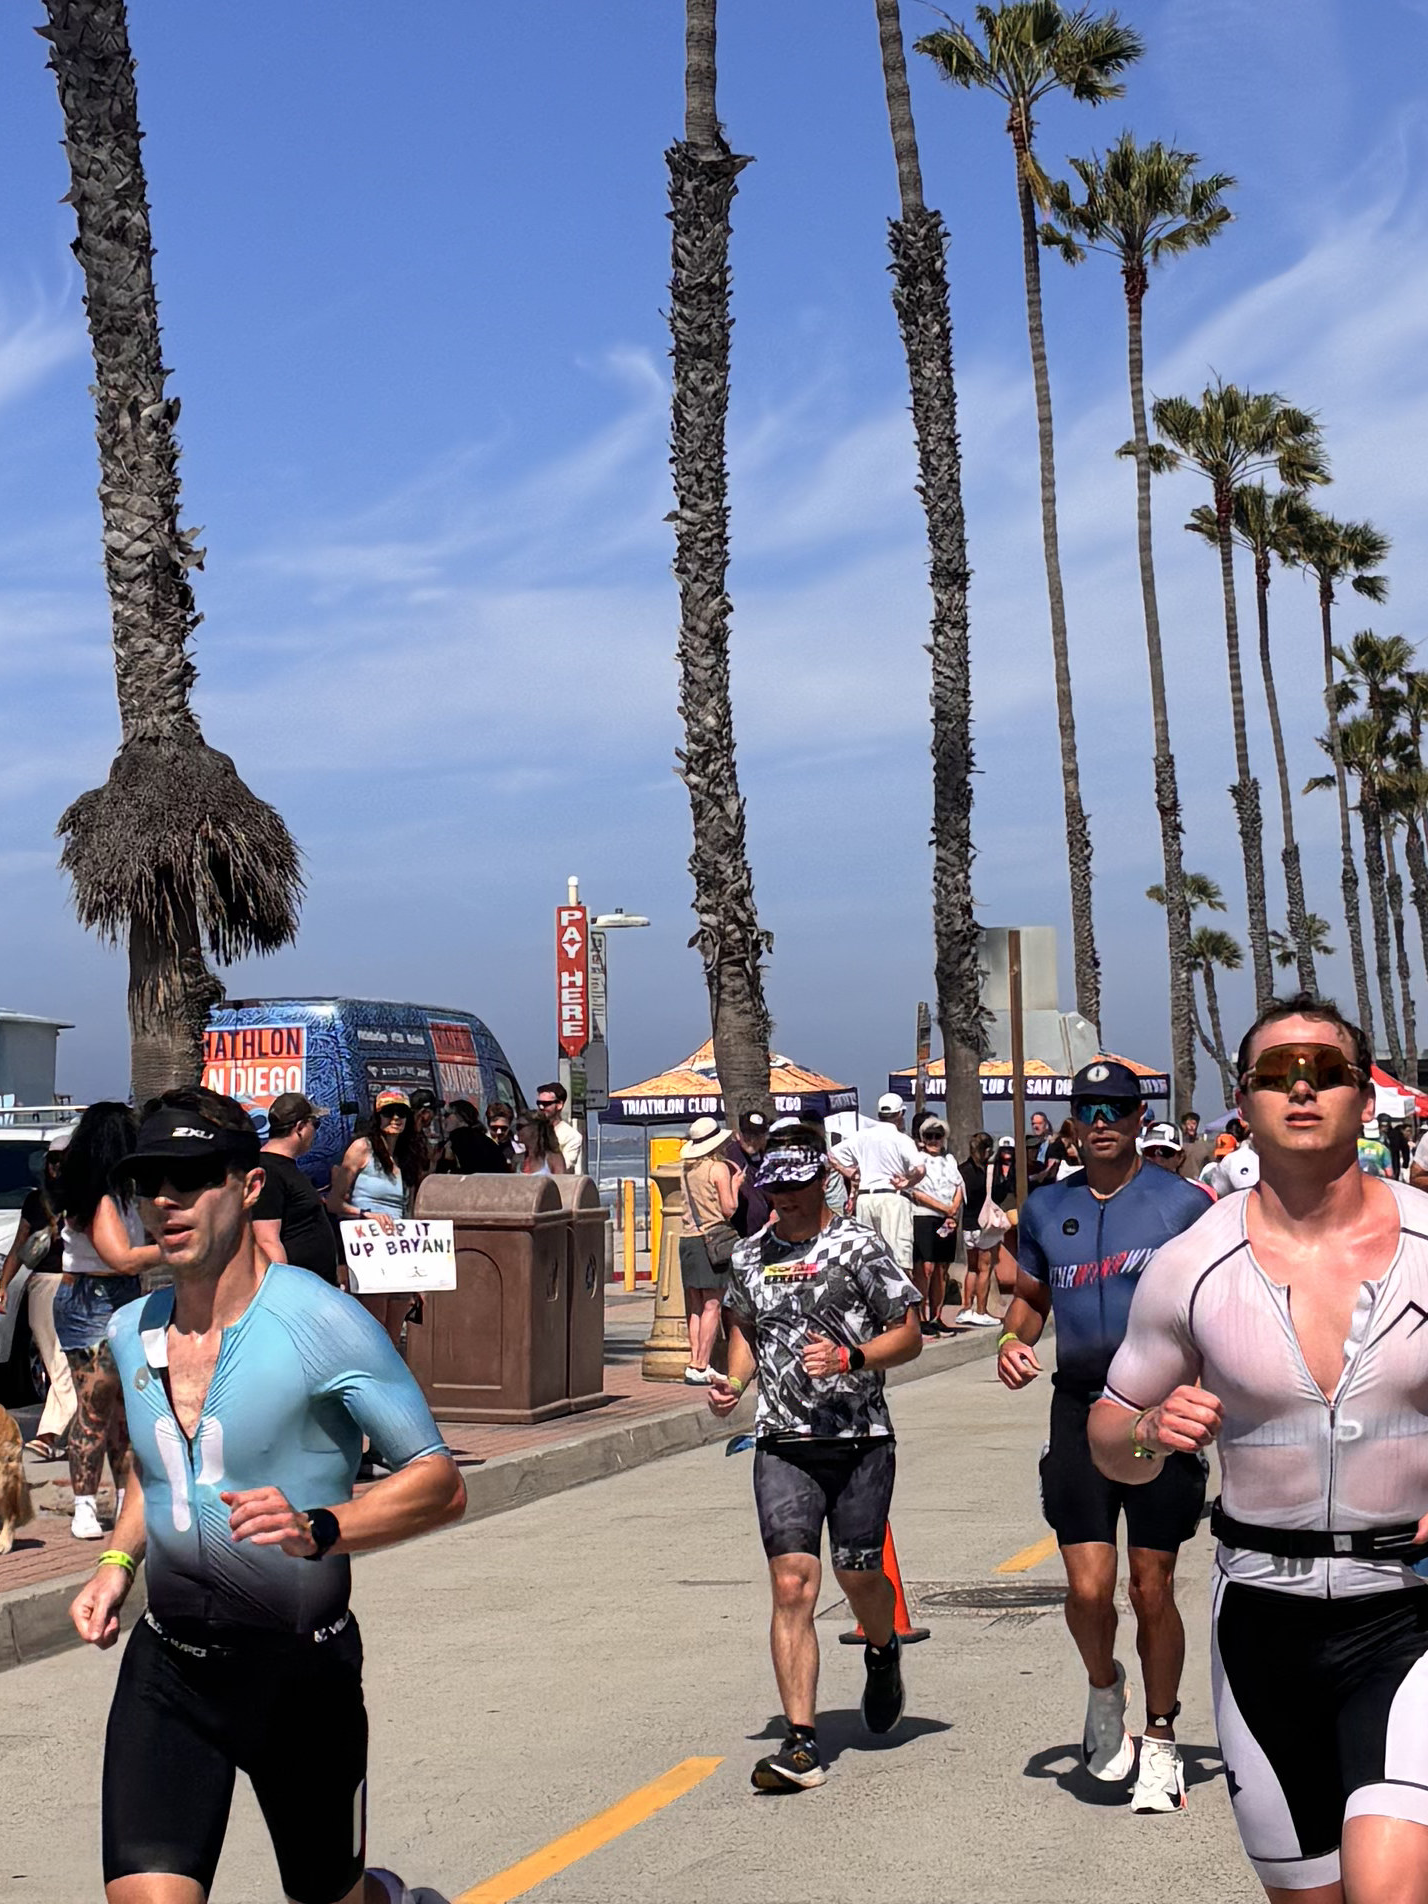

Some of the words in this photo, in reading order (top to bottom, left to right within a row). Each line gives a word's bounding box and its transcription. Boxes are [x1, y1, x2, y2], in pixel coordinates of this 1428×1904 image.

[560, 910, 584, 959] PAY
[561, 970, 585, 1037] HERE
[203, 1027, 301, 1060] IATHLON
[230, 1065, 302, 1097] DIEGO
[1026, 1079, 1052, 1095] SAN
[622, 1099, 685, 1115] TRIATHLON
[688, 1097, 718, 1113] CLUB
[172, 1127, 215, 1140] 2XU
[415, 1222, 431, 1236] IT
[350, 1242, 374, 1258] UP
[386, 1238, 451, 1255] BRYAN!
